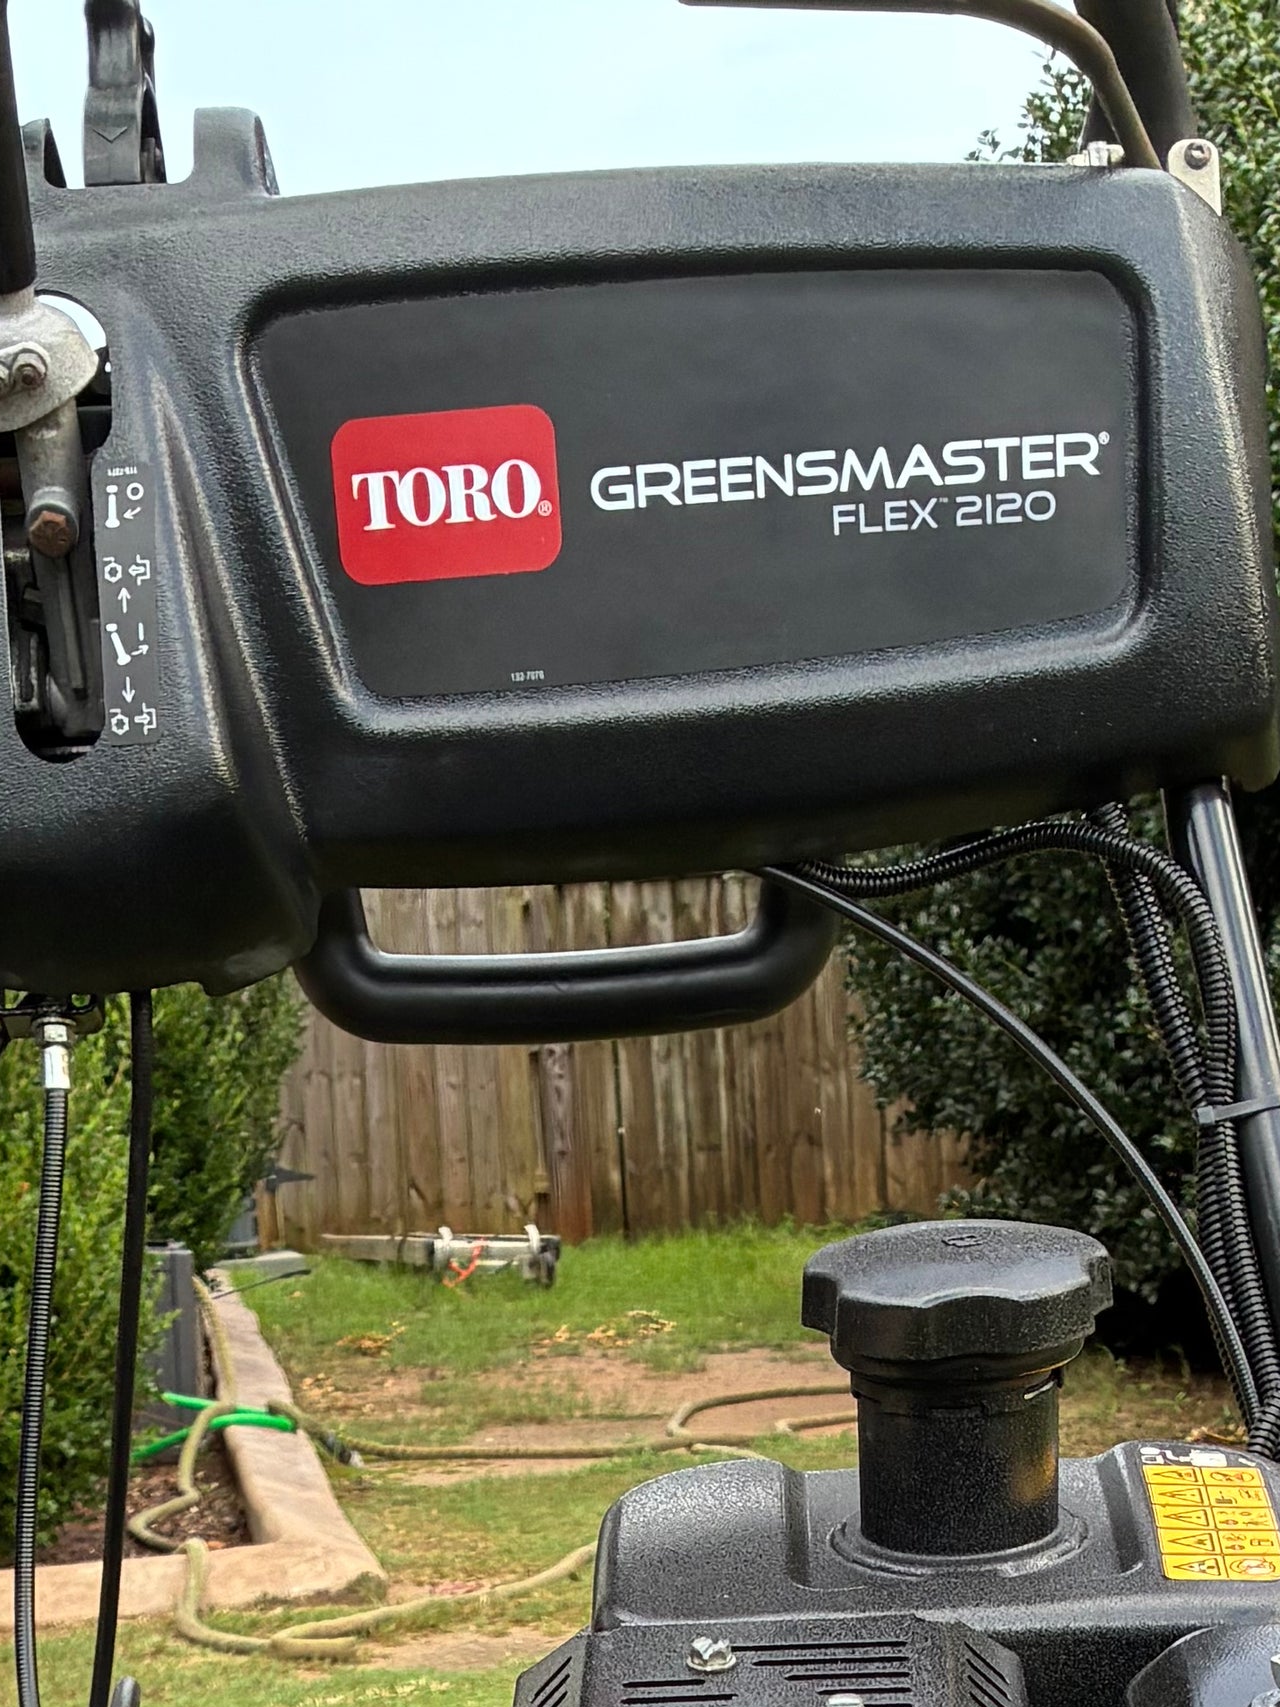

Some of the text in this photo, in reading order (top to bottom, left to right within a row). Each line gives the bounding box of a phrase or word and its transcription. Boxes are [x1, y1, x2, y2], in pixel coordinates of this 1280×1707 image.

[352, 432, 1101, 531] TORO GREENSMASTER
[832, 490, 1057, 536] FLEX 2120
